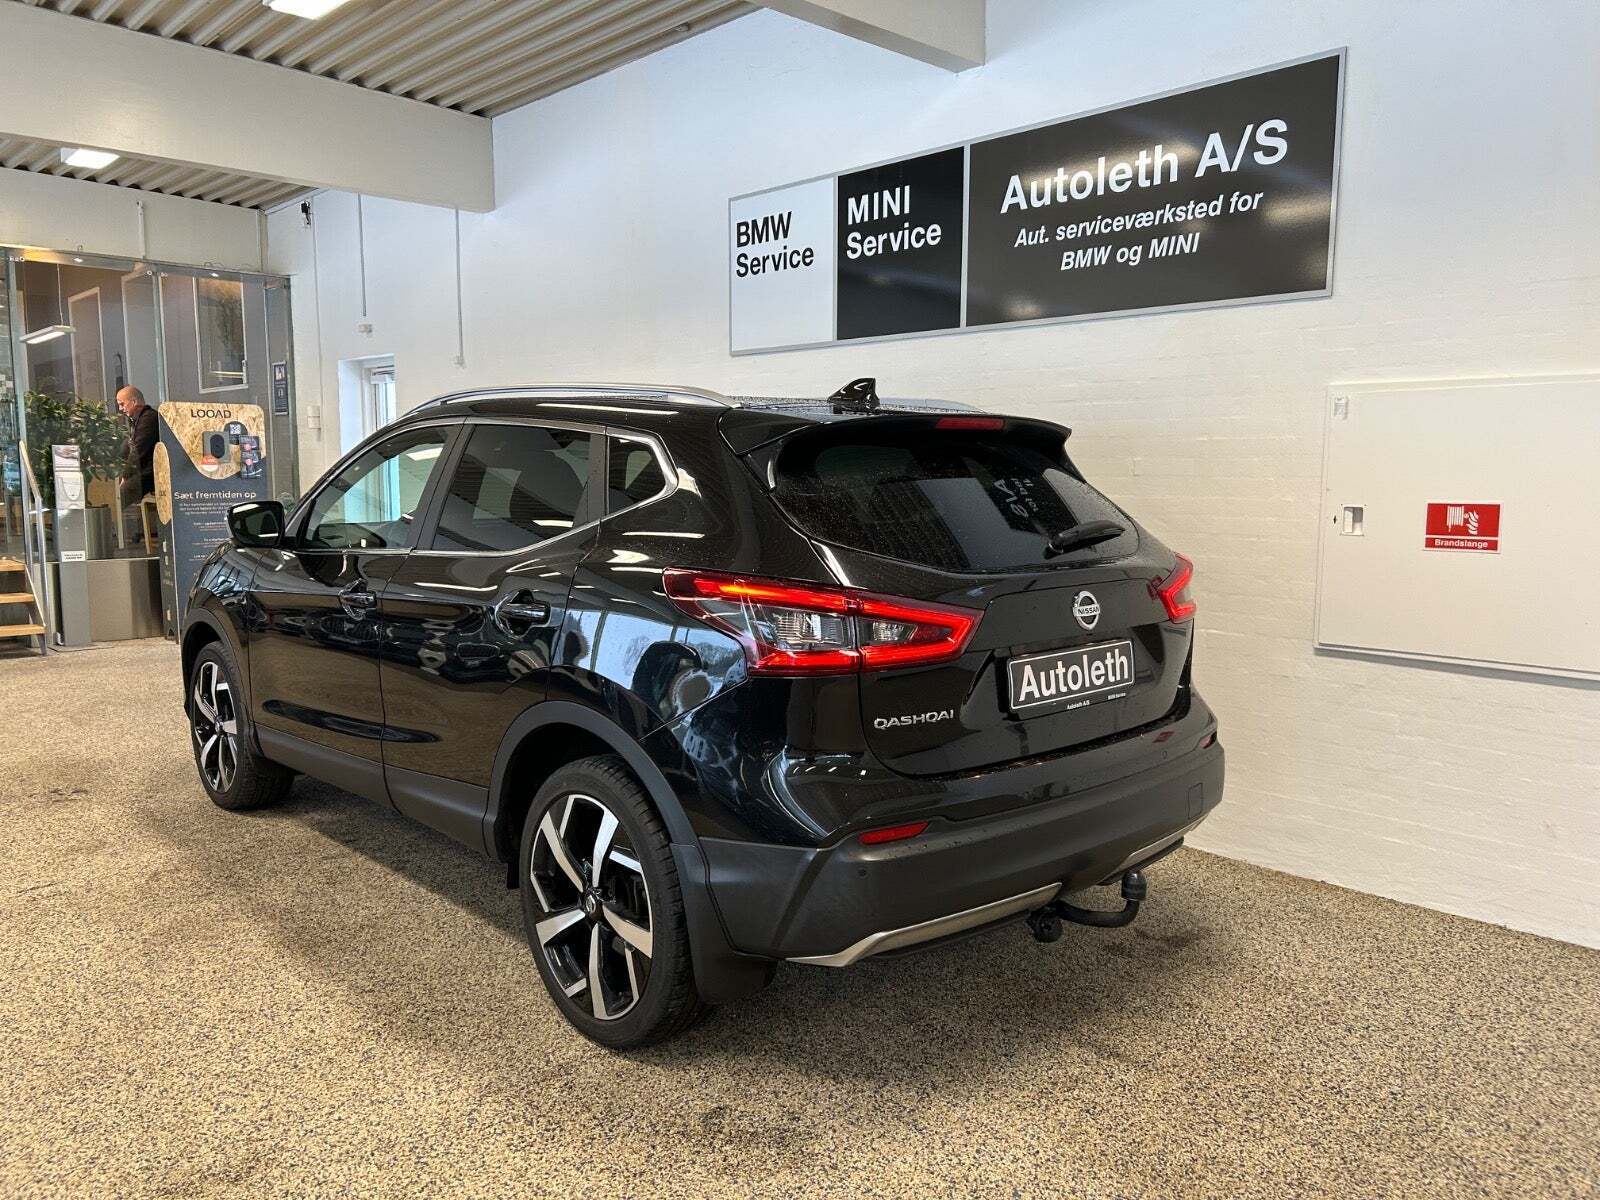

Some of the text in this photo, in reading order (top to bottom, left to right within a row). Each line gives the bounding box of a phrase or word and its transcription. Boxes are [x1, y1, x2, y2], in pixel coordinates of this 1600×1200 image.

[1000, 118, 1288, 213] Autoleth A/S
[847, 185, 911, 225] MINI
[1013, 190, 1264, 249] Aut. serviceværksted for
[735, 211, 792, 247] BMW
[846, 222, 943, 260] Service
[735, 245, 815, 278] Service
[1060, 232, 1200, 272] BMW og MINI
[190, 408, 232, 419] LOOAD
[174, 490, 193, 500] Sæt
[195, 490, 241, 499] fremtiden
[244, 491, 257, 500] op
[1434, 538, 1488, 549] Brandslange
[1078, 606, 1100, 615] NISSAN
[1019, 648, 1129, 701] Autoleth
[874, 709, 955, 730] QASHQAI
